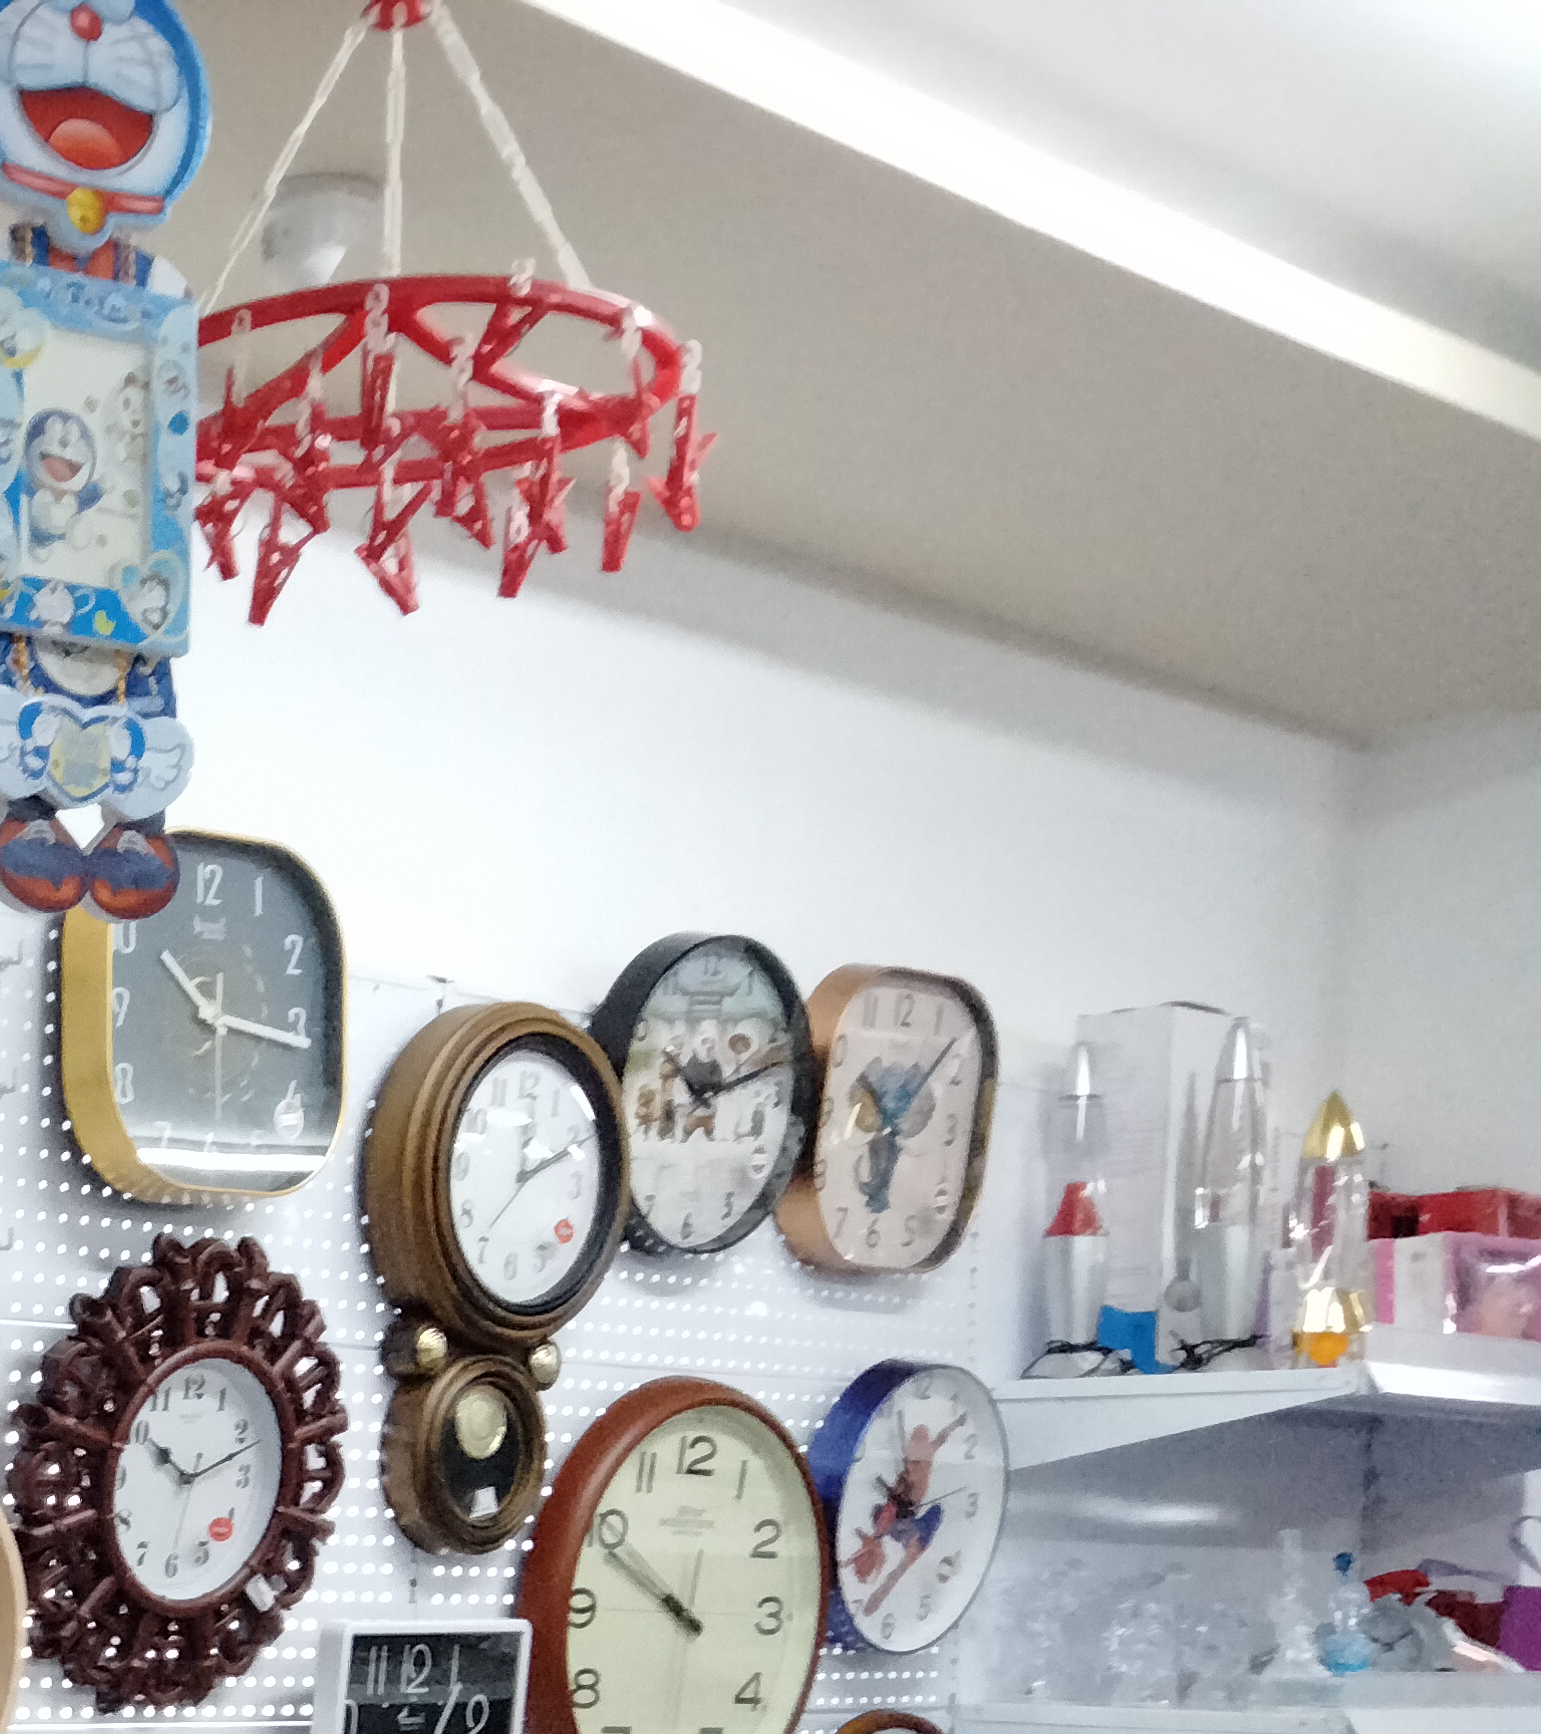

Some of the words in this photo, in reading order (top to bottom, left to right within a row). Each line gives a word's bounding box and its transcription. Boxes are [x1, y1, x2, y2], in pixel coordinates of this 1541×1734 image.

[196, 862, 223, 906] 12
[255, 876, 264, 917] 1
[284, 934, 303, 976] 2
[113, 987, 130, 1027] 9
[893, 994, 915, 1027] 12
[114, 1063, 134, 1104] 8
[490, 1077, 507, 1106] 11
[517, 1070, 540, 1100] 12
[944, 1113, 958, 1146] 3
[833, 1207, 848, 1239] 7
[867, 1218, 880, 1248] 6
[901, 1215, 917, 1247] 5
[478, 1236, 489, 1264] 7
[149, 1386, 172, 1412] 11
[183, 1373, 205, 1400] 12
[217, 1388, 227, 1411] 1
[234, 1419, 249, 1444] 2
[635, 1451, 657, 1494] 11
[676, 1435, 716, 1476] 12
[236, 1464, 251, 1488] 3
[736, 1459, 747, 1500] 1
[587, 1509, 629, 1549] 10
[750, 1519, 782, 1559] 2
[165, 1552, 179, 1578] 6
[195, 1540, 209, 1567] 5
[567, 1588, 596, 1629] 9
[754, 1596, 784, 1635] 3
[368, 1645, 388, 1695] 11
[400, 1644, 432, 1694] 12
[449, 1644, 460, 1689] 1
[572, 1668, 599, 1709] 8
[734, 1672, 763, 1711] 4
